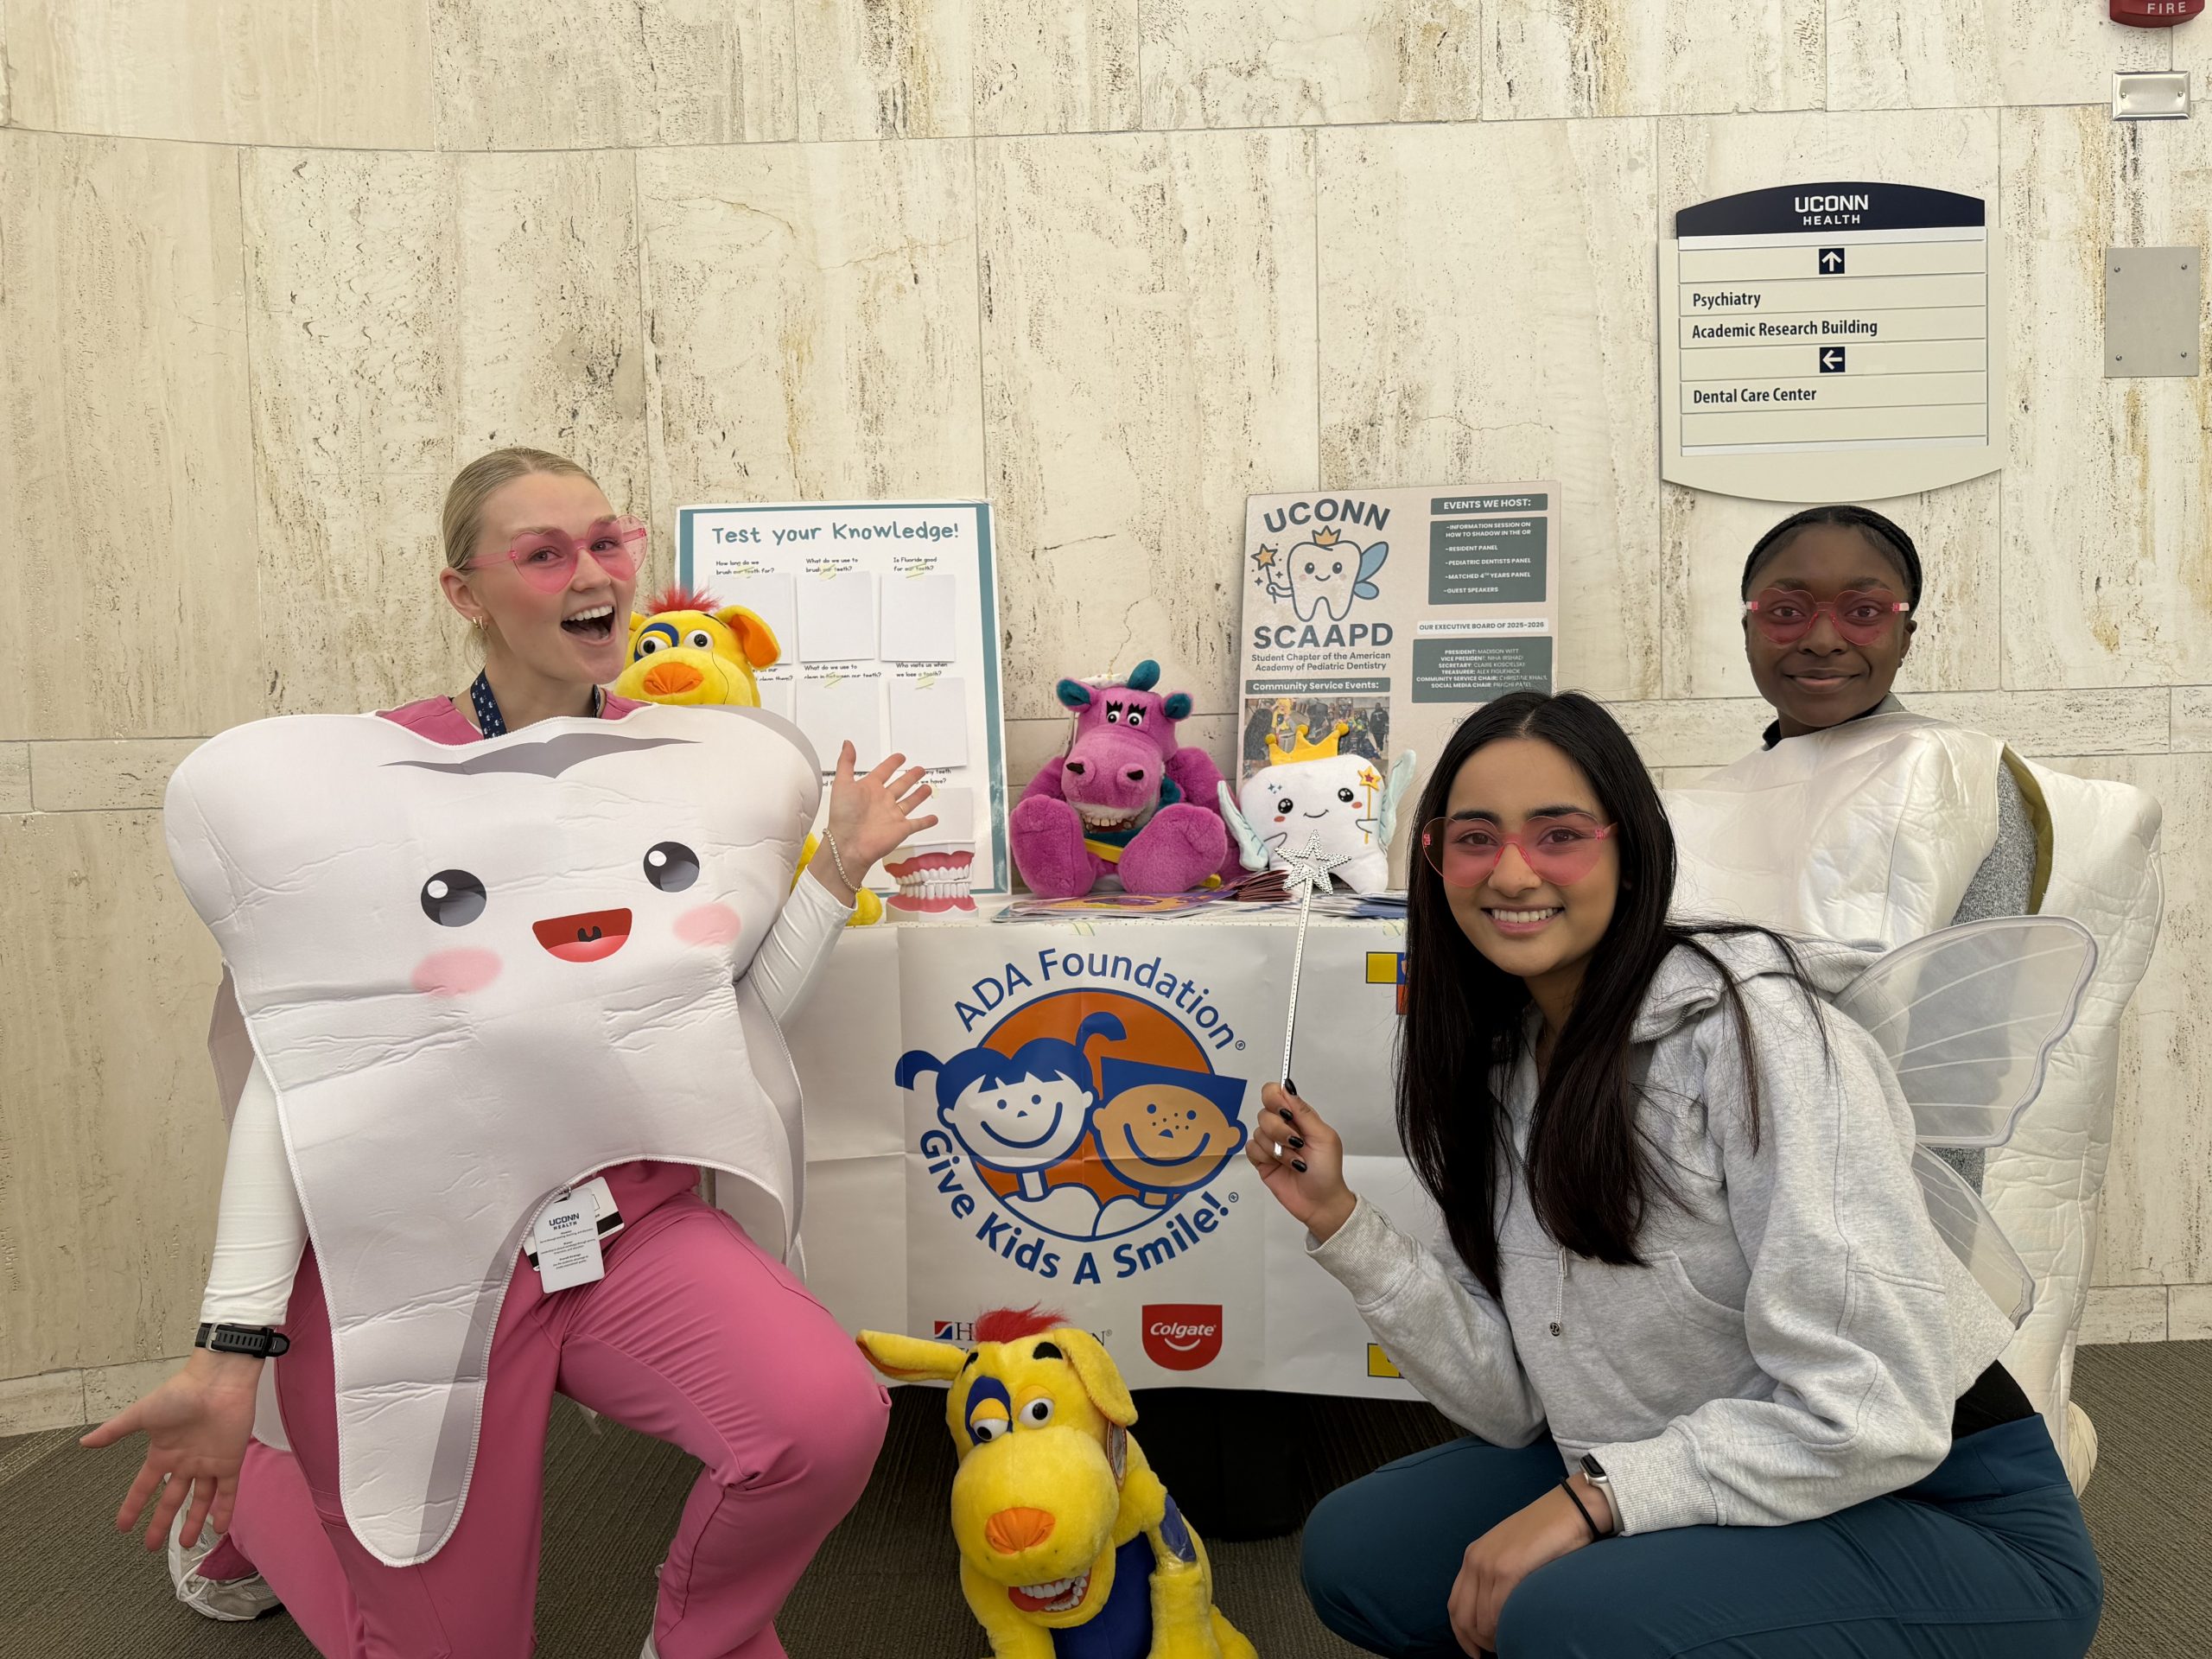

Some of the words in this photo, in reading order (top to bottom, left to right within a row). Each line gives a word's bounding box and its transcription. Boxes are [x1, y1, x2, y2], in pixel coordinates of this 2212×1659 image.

[2147, 2, 2186, 14] FIRE
[1795, 194, 1869, 213] UCONN
[1802, 214, 1860, 226] HEALTH
[1693, 292, 1761, 310] Psychiatry
[1692, 323, 1756, 339] Academic
[1759, 321, 1818, 336] Research
[1821, 320, 1878, 336] Building
[1694, 389, 1738, 404] Dental
[1740, 388, 1770, 402] Care
[1773, 387, 1817, 401] Center
[1444, 500, 1481, 510] EVENTS
[1501, 499, 1531, 507] HOST:
[1263, 499, 1390, 532] UCONN
[712, 527, 761, 544] Test
[772, 527, 822, 546] your
[832, 521, 958, 543] Knowledge!
[1253, 623, 1393, 649] SCAAPD
[1287, 653, 1321, 663] Chapter
[1255, 664, 1294, 672] Academy
[1346, 662, 1387, 671] Dentistry
[1253, 683, 1306, 691] Community
[1344, 681, 1379, 690] Events:
[953, 962, 1033, 1033] ADA
[920, 1129, 976, 1220] Give
[976, 1211, 1061, 1279] Kids
[1072, 1251, 1102, 1285] A
[549, 1213, 580, 1225] UCONN
[554, 1221, 576, 1230] HEALTH
[1150, 1321, 1215, 1338] Colgate
